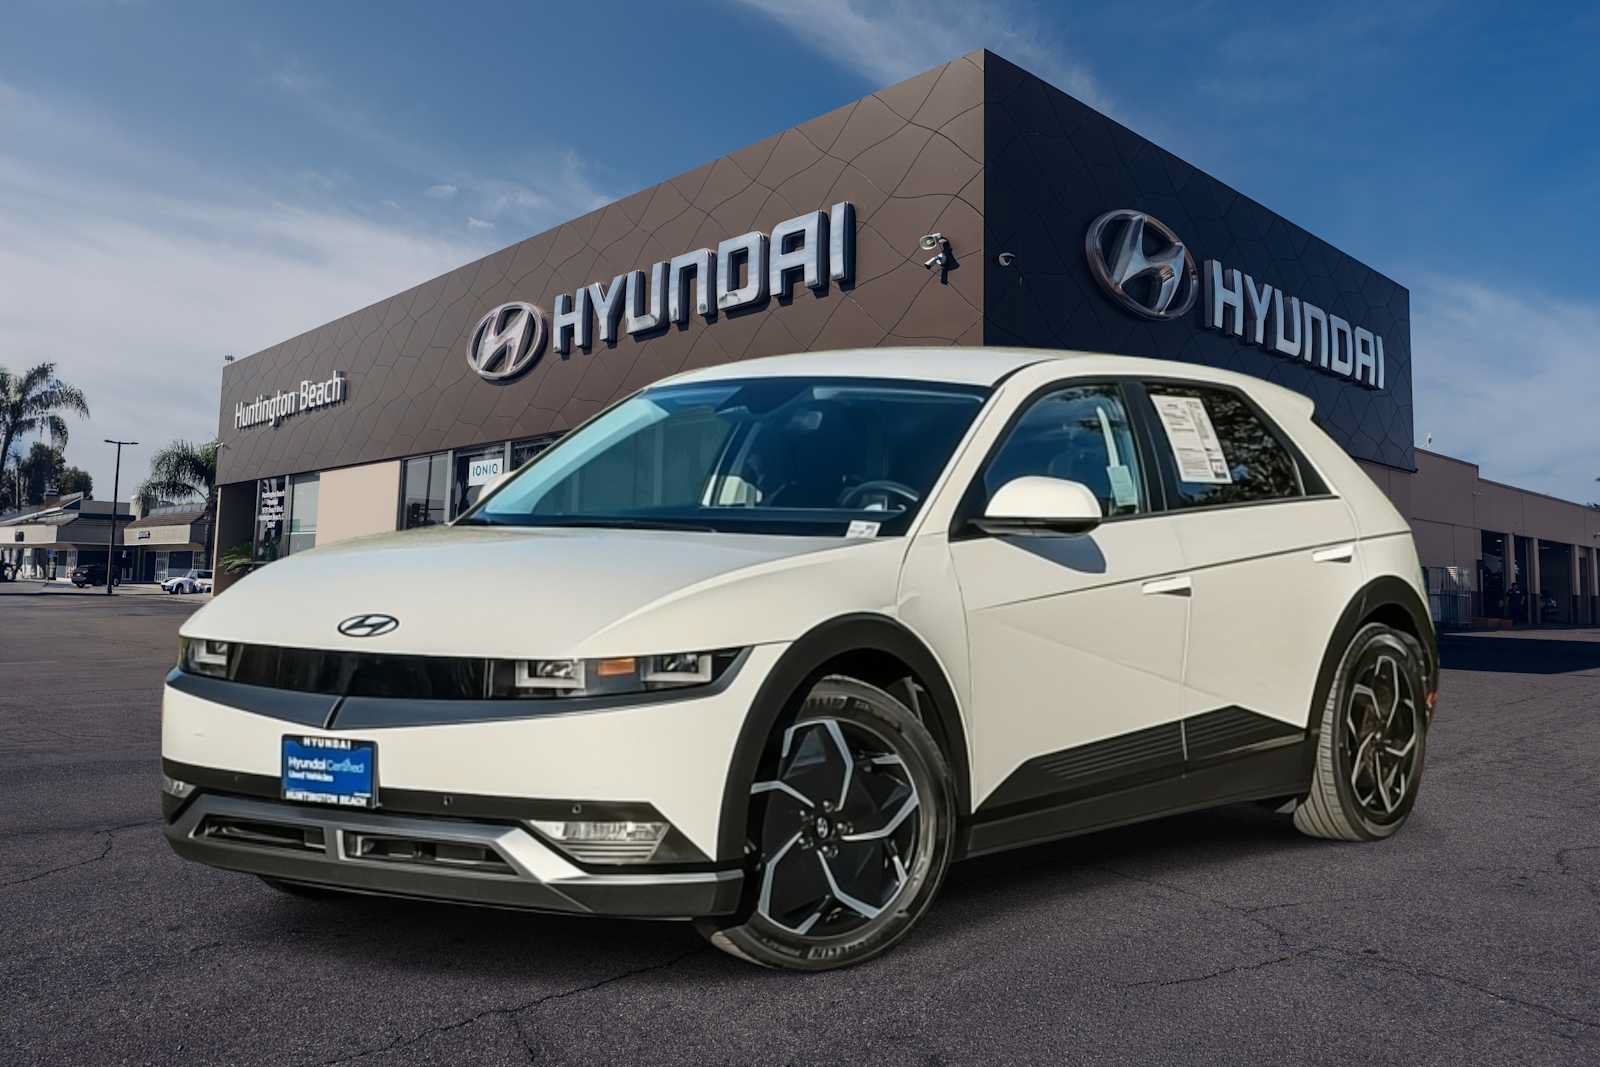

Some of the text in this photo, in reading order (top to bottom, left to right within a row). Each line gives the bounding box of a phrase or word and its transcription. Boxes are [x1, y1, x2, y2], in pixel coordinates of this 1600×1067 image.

[553, 201, 855, 354] HYUNDAI
[1205, 259, 1385, 390] HYUNDAI
[234, 370, 345, 429] Huntington Beach
[303, 737, 351, 750] HYUNDAI
